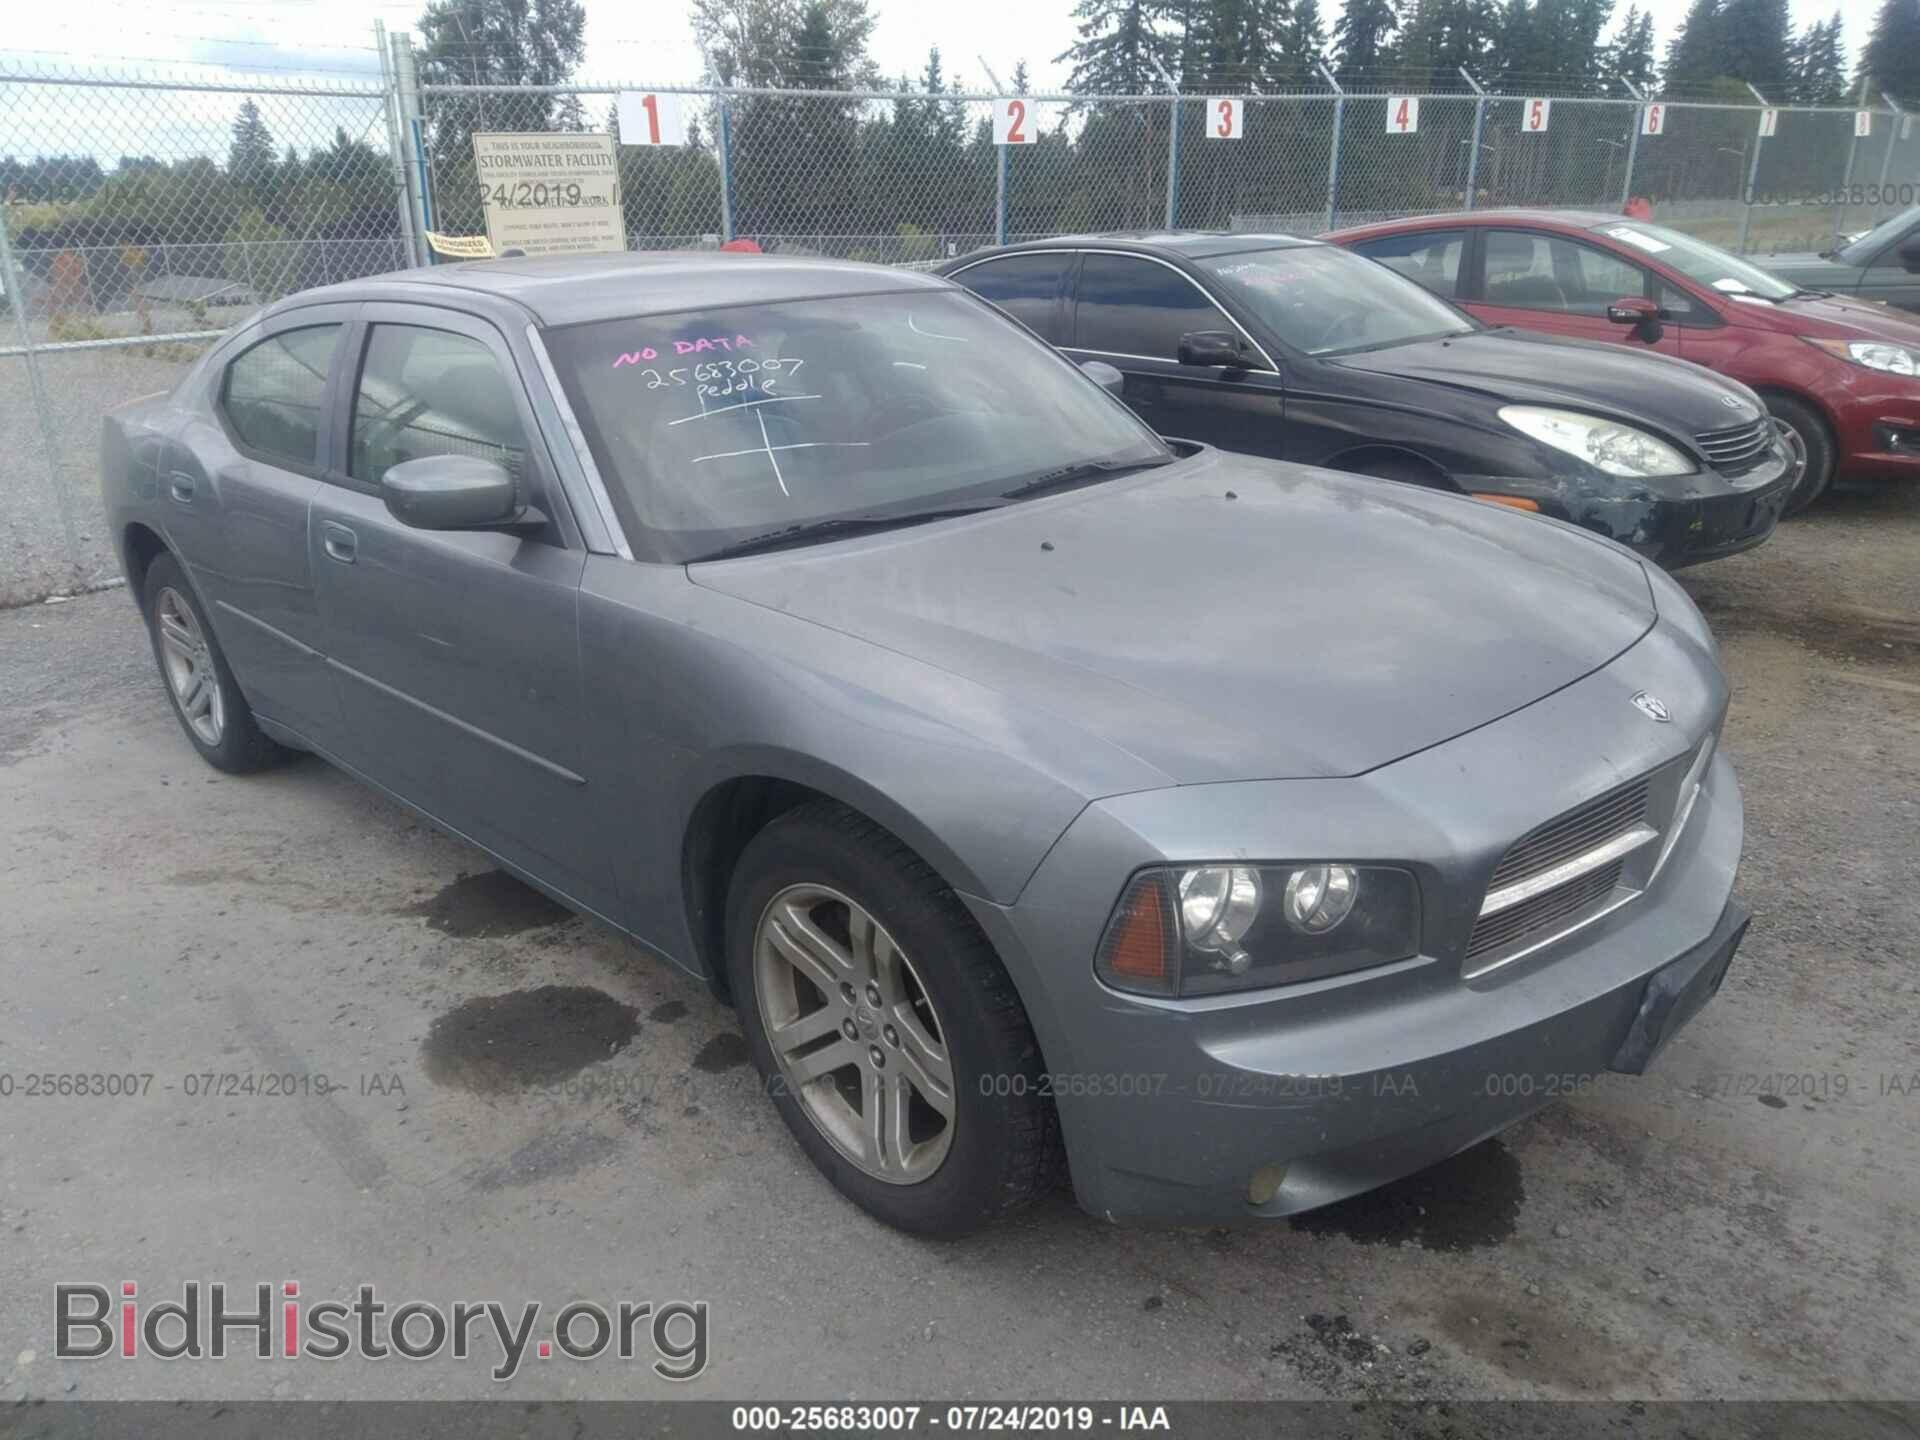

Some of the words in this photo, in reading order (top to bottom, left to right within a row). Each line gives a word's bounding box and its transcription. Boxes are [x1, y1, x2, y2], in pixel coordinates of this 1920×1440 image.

[641, 94, 661, 144] 1
[1007, 99, 1025, 143] 2
[1216, 100, 1233, 138] 3
[1395, 99, 1409, 132] 4
[1529, 100, 1543, 131] 5
[1648, 104, 1660, 133] 6
[481, 154, 562, 168] STORMWATER
[566, 153, 612, 167] FACILITY
[612, 347, 657, 368] NO
[673, 334, 754, 354] DATA
[641, 358, 803, 389] 25683007
